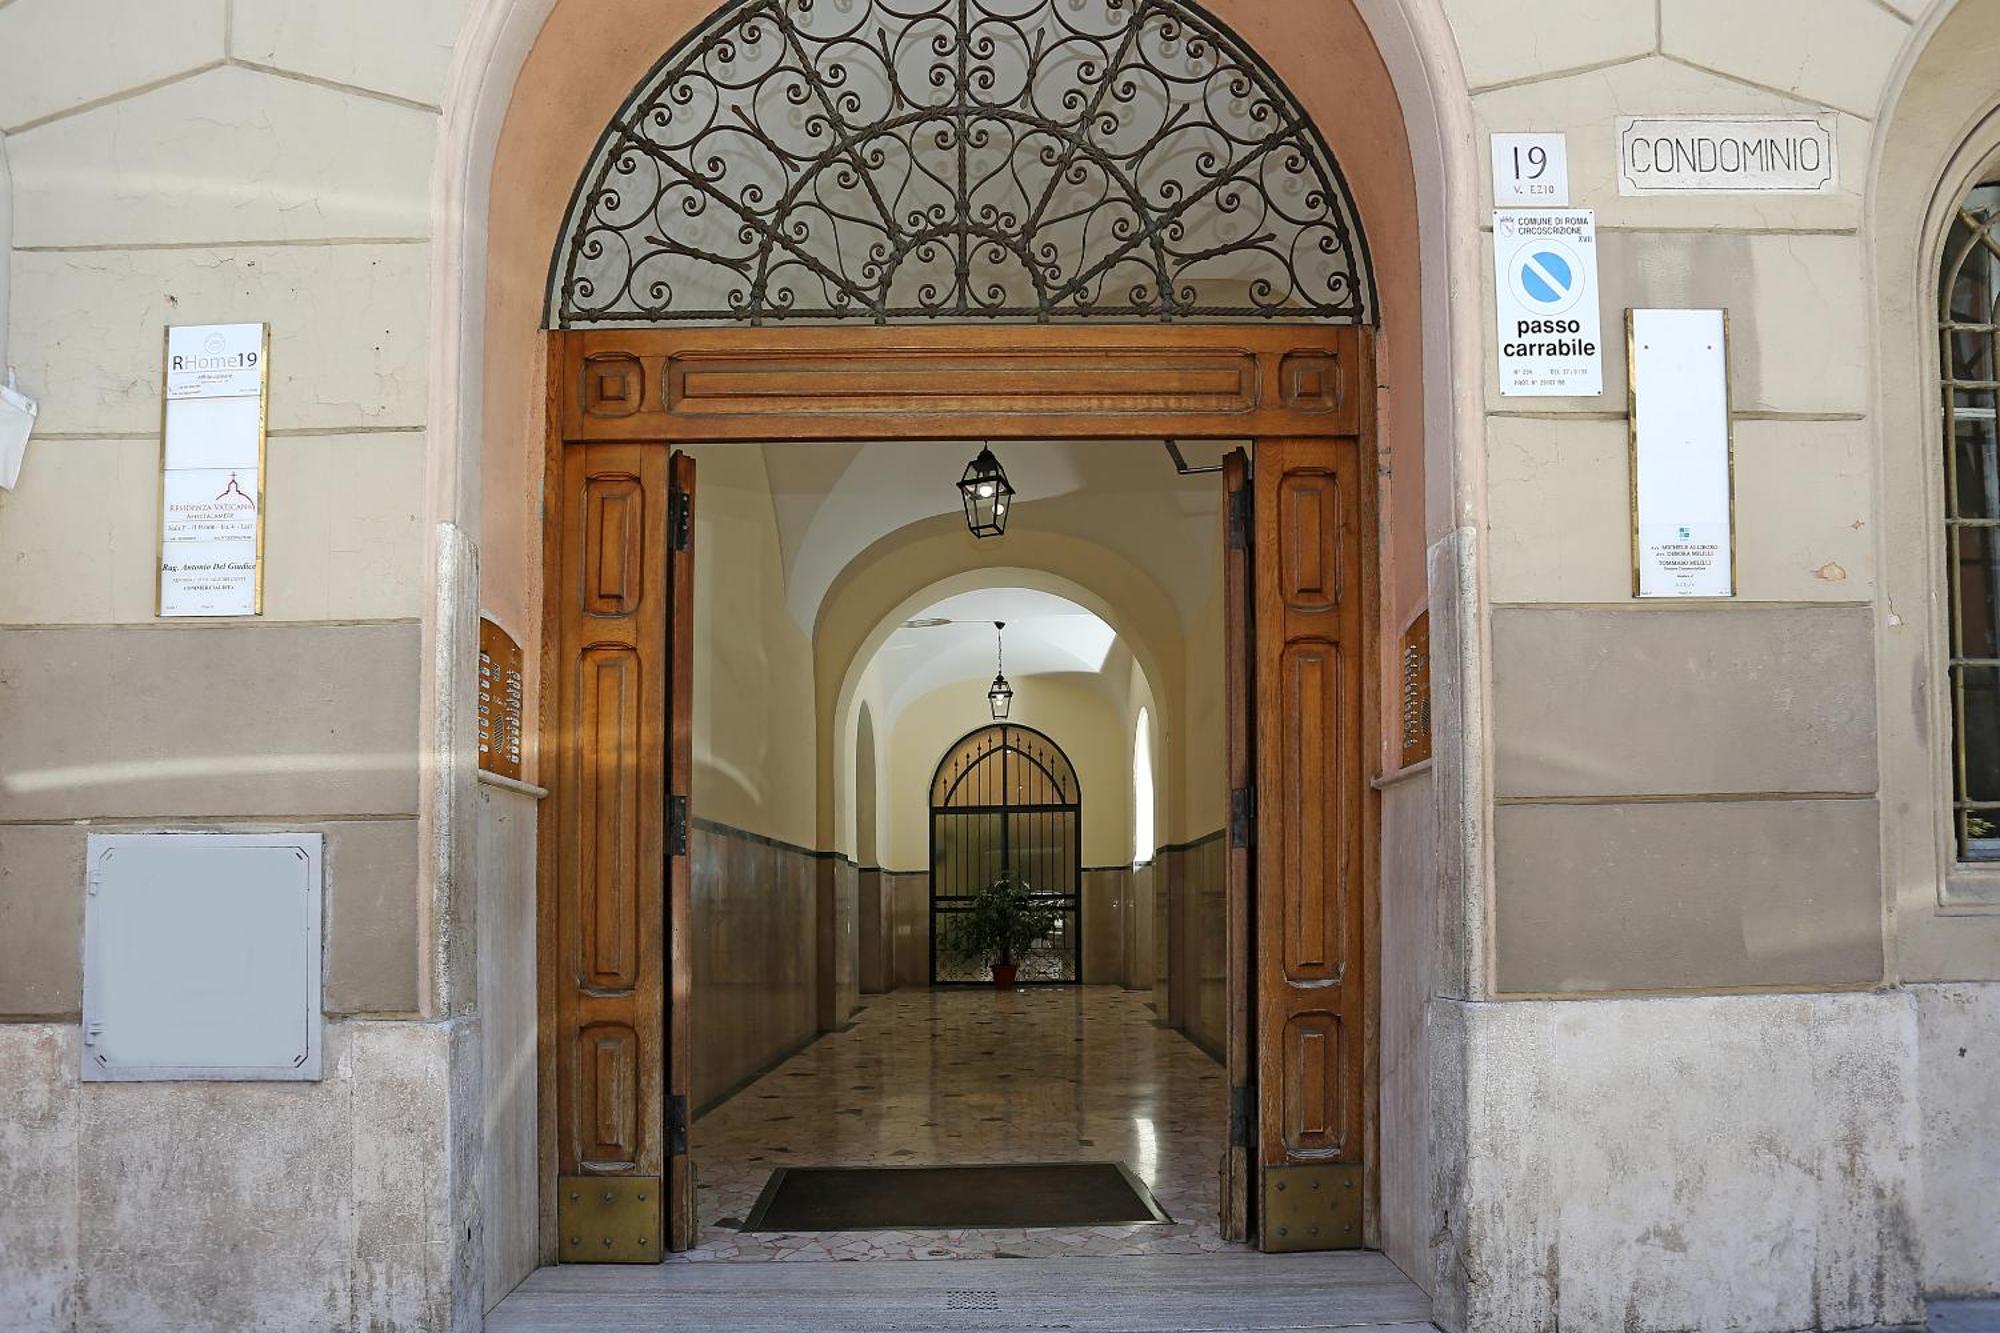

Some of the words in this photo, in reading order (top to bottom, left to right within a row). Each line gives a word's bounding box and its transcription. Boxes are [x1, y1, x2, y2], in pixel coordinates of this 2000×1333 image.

[1631, 137, 1820, 173] CONDOMINIO
[1513, 146, 1547, 180] 19
[1530, 184, 1554, 194] EZIO
[1518, 217, 1553, 226] COMUNE
[1554, 217, 1563, 226] DI
[1564, 216, 1589, 225] ROMA
[1518, 226, 1583, 235] CIRCOSCRIZIONE
[1517, 319, 1580, 338] passo
[1503, 338, 1596, 357] carrabile
[170, 504, 212, 512] RESIDENZA
[213, 503, 253, 511] VATICANA
[182, 563, 212, 571] Antonio
[227, 562, 257, 570] Giudice
